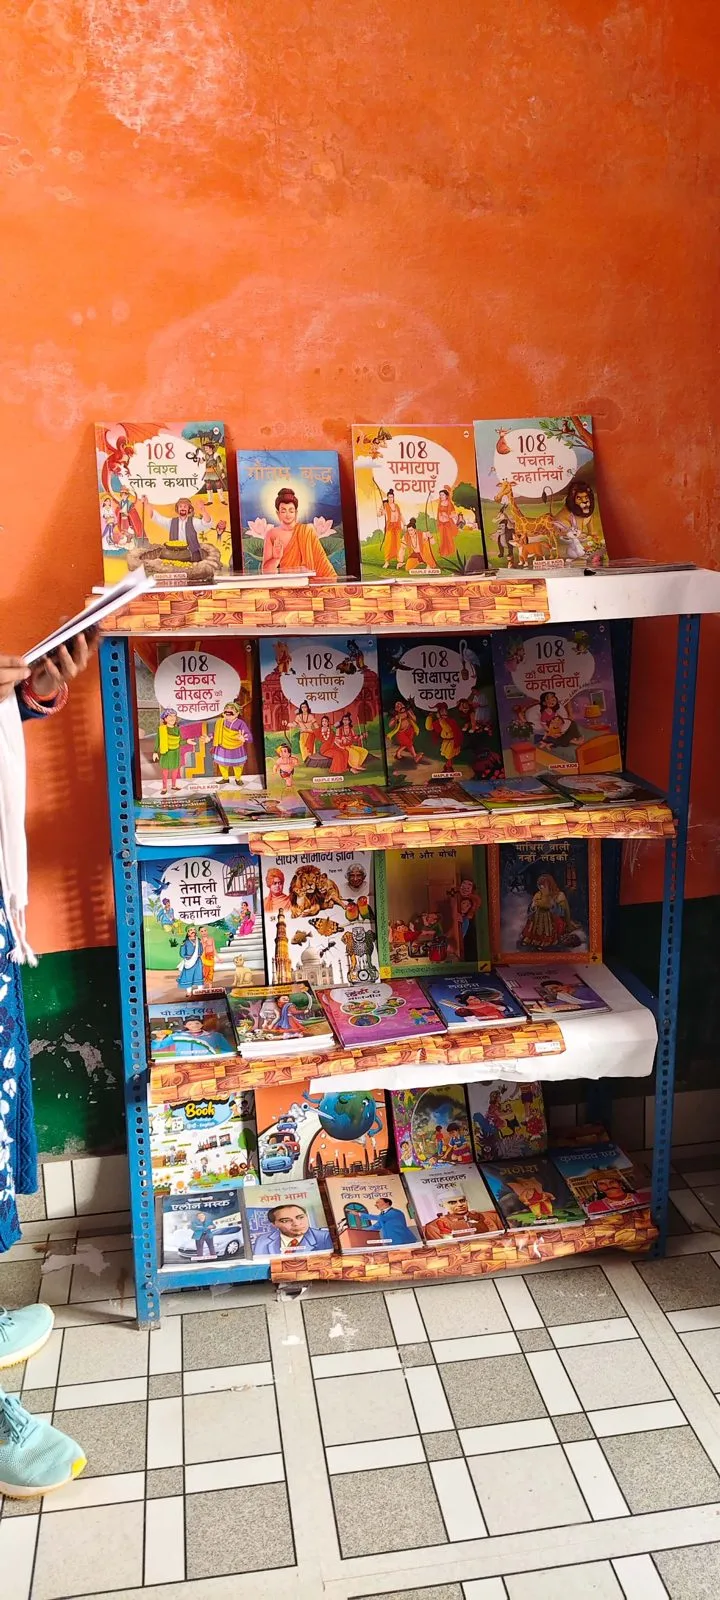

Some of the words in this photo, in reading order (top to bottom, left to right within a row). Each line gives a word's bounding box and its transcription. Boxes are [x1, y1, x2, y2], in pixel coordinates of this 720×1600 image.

[145, 442, 176, 460] 108
[399, 440, 428, 460] 108
[518, 433, 547, 453] 108
[147, 461, 177, 475] विश्व
[387, 461, 440, 475] रामायण
[517, 452, 555, 467] पंचतंत्र
[247, 459, 290, 481] गौतम
[298, 466, 333, 487] बुद्ध
[511, 466, 563, 483] कहानियाँ
[128, 475, 157, 489] लोक
[162, 473, 199, 491] कथाएँ
[393, 475, 437, 493] कथाएँ
[535, 640, 565, 660] 108
[180, 655, 209, 672] 108
[305, 652, 334, 671] 108
[421, 649, 449, 669] 108
[536, 659, 566, 675] बच्चों
[175, 673, 216, 686] अकबर
[297, 672, 345, 687] पौराणिक
[412, 668, 460, 685] शिक्षाप्रद
[524, 672, 580, 692] कहानियाँ
[174, 687, 213, 700] बीरबल
[305, 687, 339, 703] कथाएँ
[418, 684, 456, 701] कथाएँ
[177, 699, 220, 714] कहानियाँ
[419, 849, 434, 859] और
[183, 860, 212, 878] 108
[179, 879, 217, 894] तेनाली
[181, 896, 201, 907] राम
[205, 896, 218, 906] की
[179, 906, 221, 920] कहानियाँ
[184, 1101, 215, 1120] Book
[171, 1202, 201, 1211] एलोन
[204, 1200, 231, 1208] मस्क
